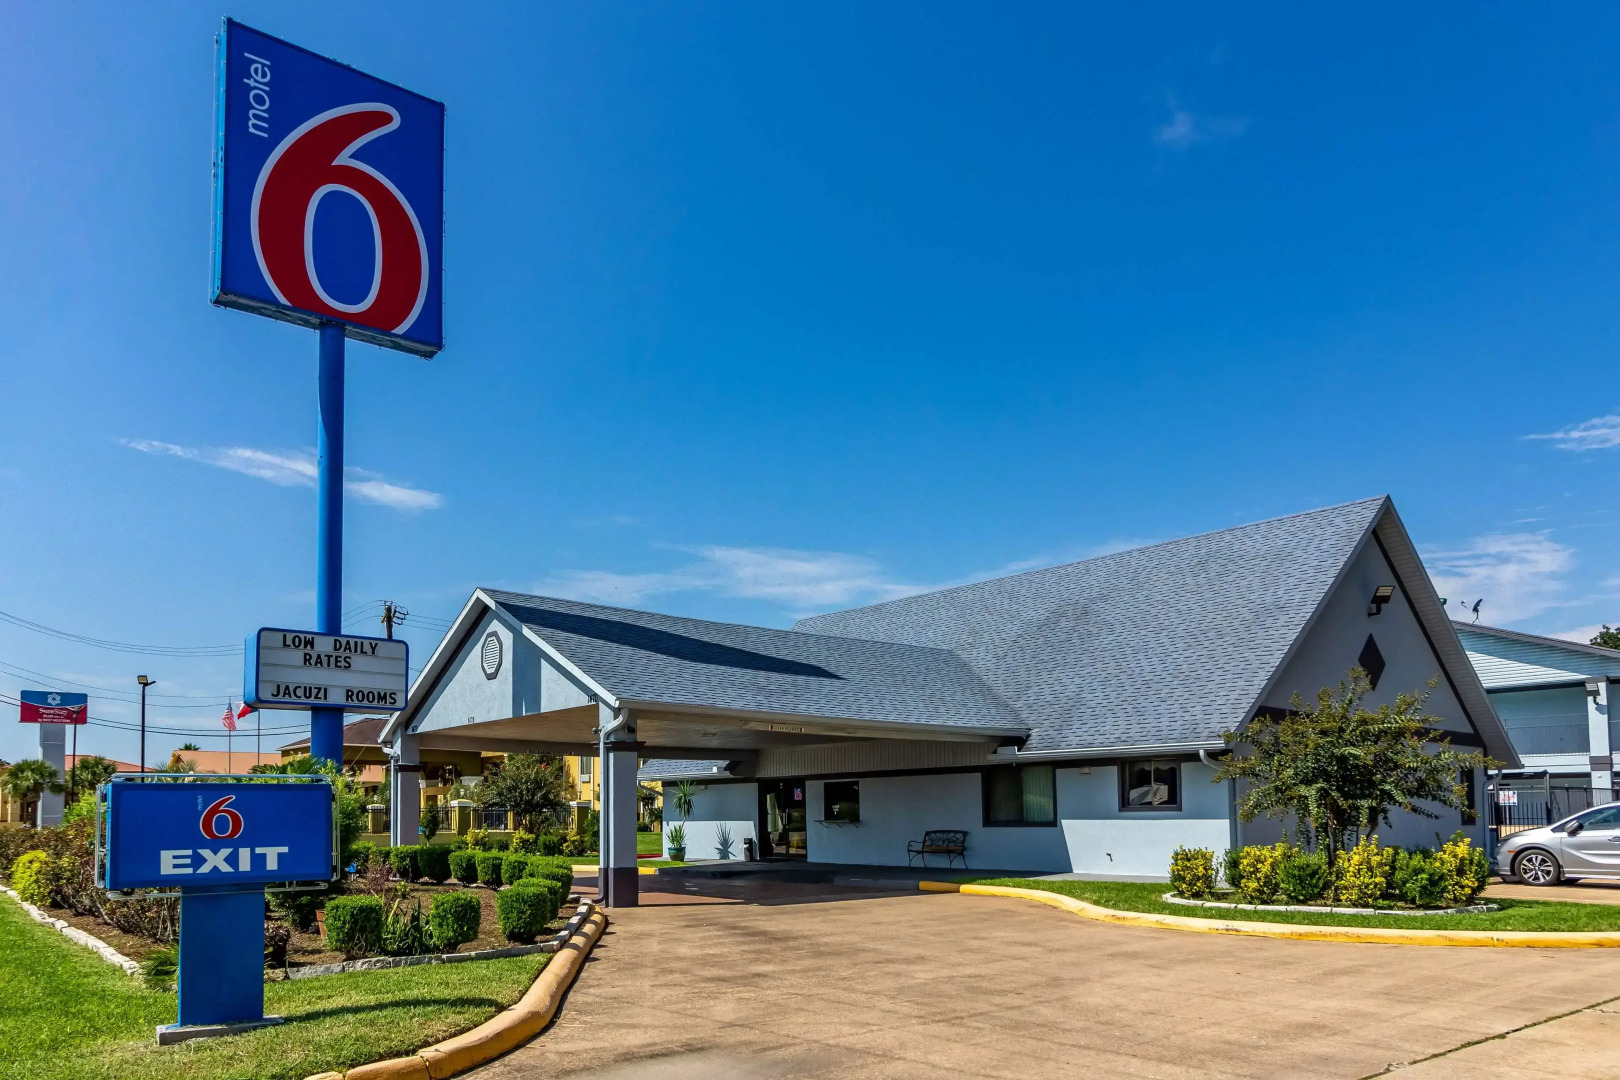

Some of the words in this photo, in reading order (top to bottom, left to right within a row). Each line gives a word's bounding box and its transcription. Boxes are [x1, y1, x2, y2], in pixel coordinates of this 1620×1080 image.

[244, 52, 271, 138] motel
[251, 102, 429, 335] 6
[282, 633, 315, 650] LOW
[333, 638, 379, 655] DAILY
[303, 652, 352, 669] RATES
[271, 683, 328, 701] JACUZI
[345, 689, 397, 705] ROOMS
[199, 794, 245, 840] 6
[160, 846, 289, 875] EXIT
